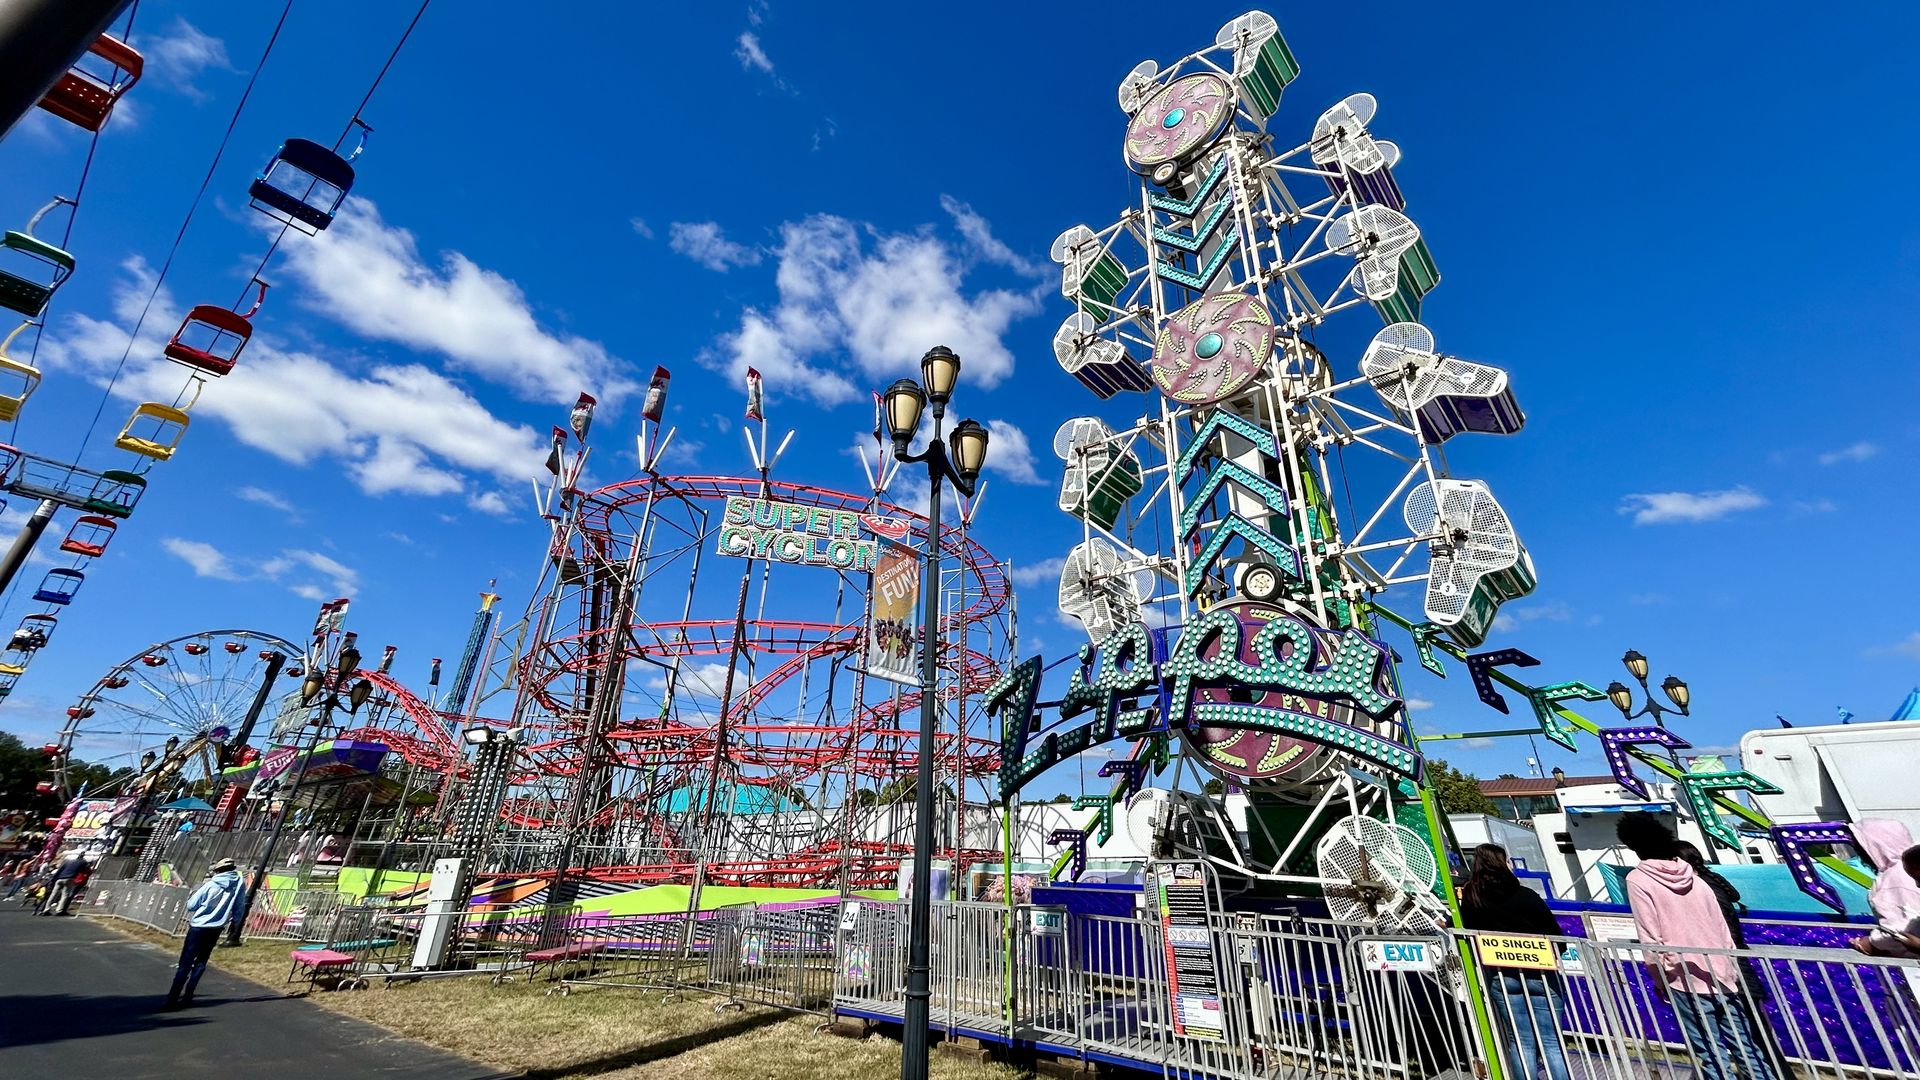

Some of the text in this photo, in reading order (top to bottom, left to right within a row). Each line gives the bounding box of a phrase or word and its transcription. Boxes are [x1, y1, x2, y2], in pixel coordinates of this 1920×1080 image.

[725, 496, 859, 540] SUPER
[881, 566, 919, 606] FUN!
[842, 911, 856, 924] 24
[1035, 913, 1060, 928] EXIT
[1481, 937, 1548, 951] NO SINGLE
[1383, 943, 1424, 962] EXIT
[1495, 951, 1541, 963] RIDERS
